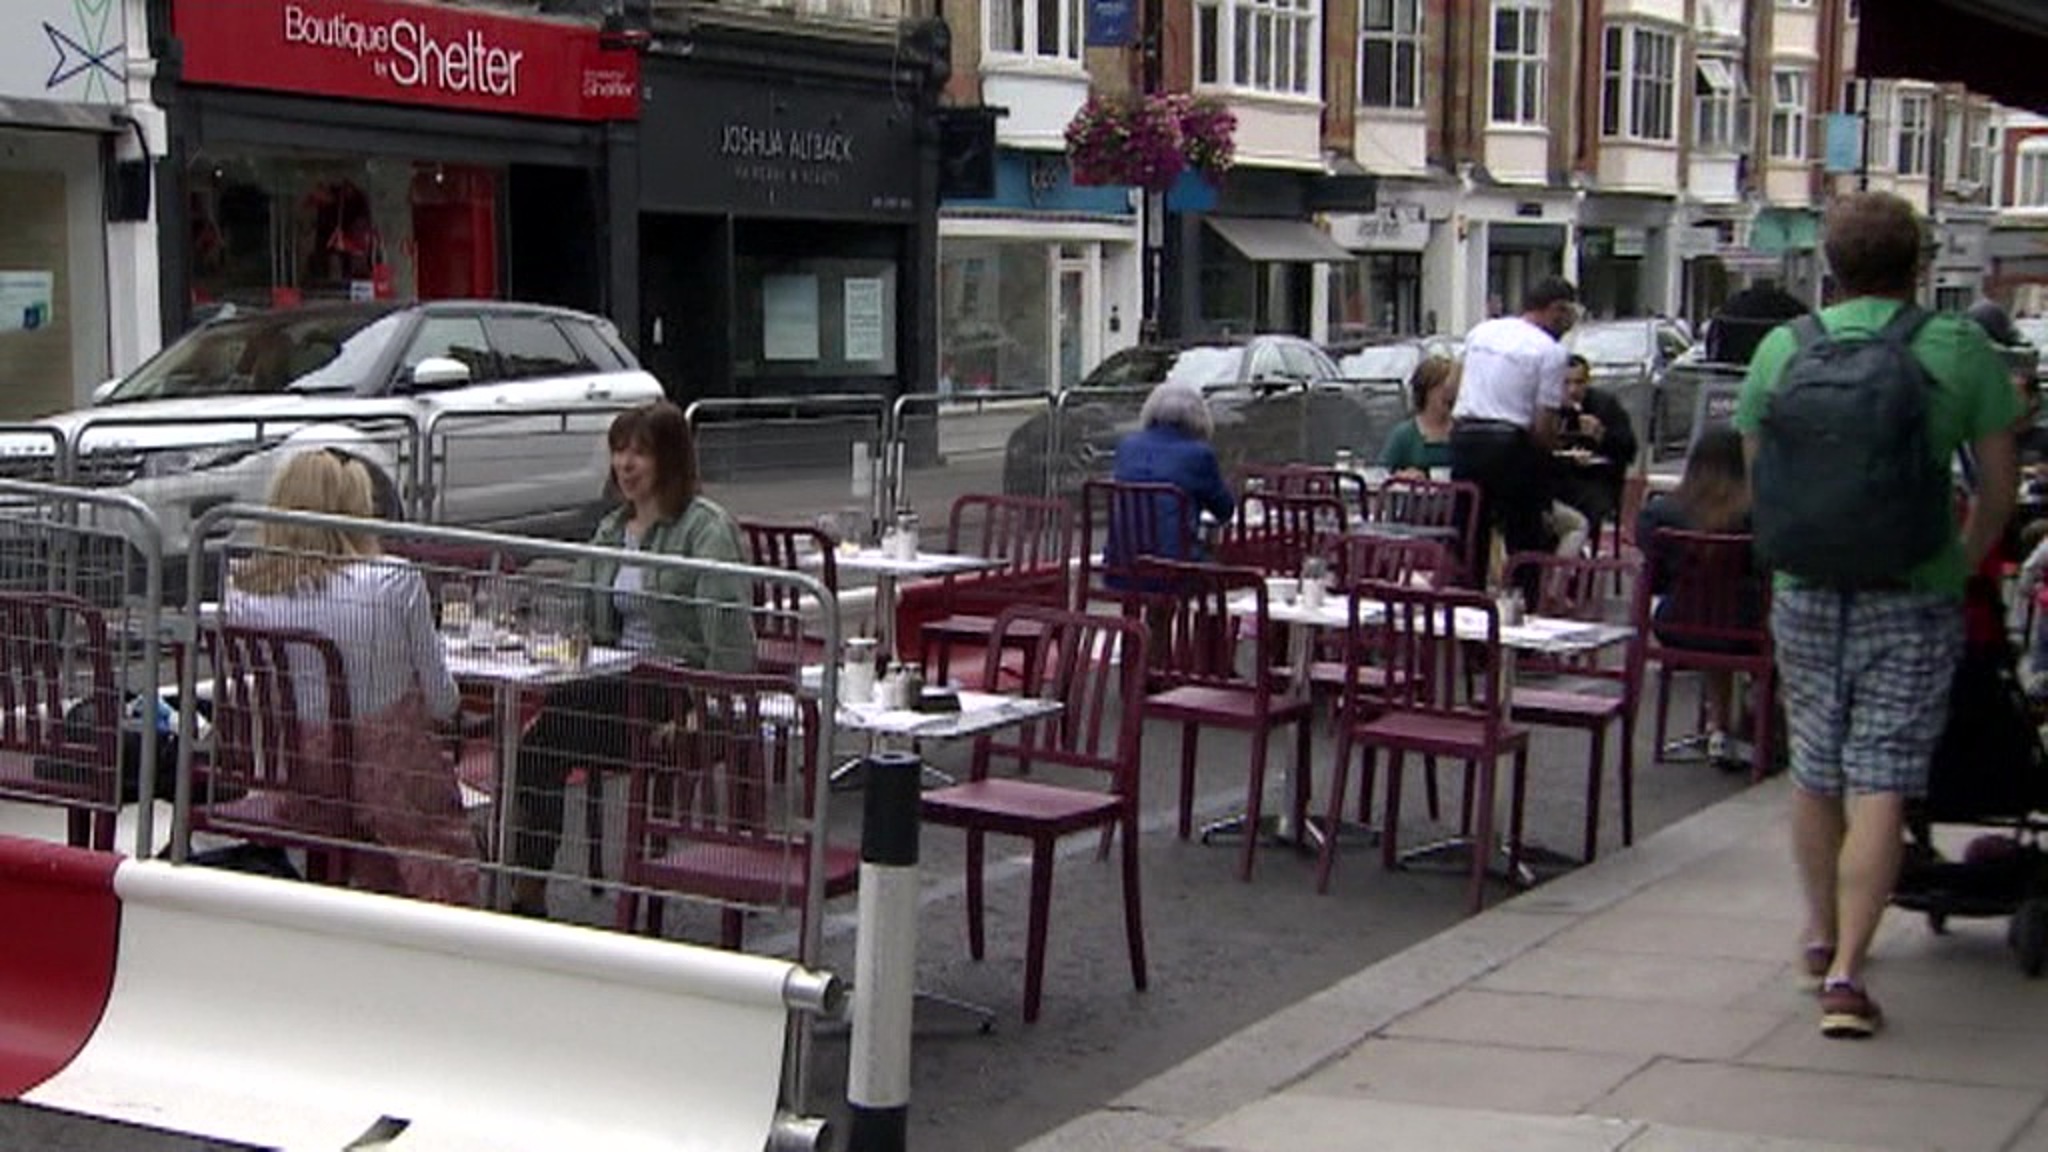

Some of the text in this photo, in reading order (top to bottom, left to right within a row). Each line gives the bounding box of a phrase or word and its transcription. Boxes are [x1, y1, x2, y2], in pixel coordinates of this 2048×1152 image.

[285, 6, 388, 57] Boutique
[390, 18, 523, 96] Shelter
[721, 124, 783, 157] JOSHUA
